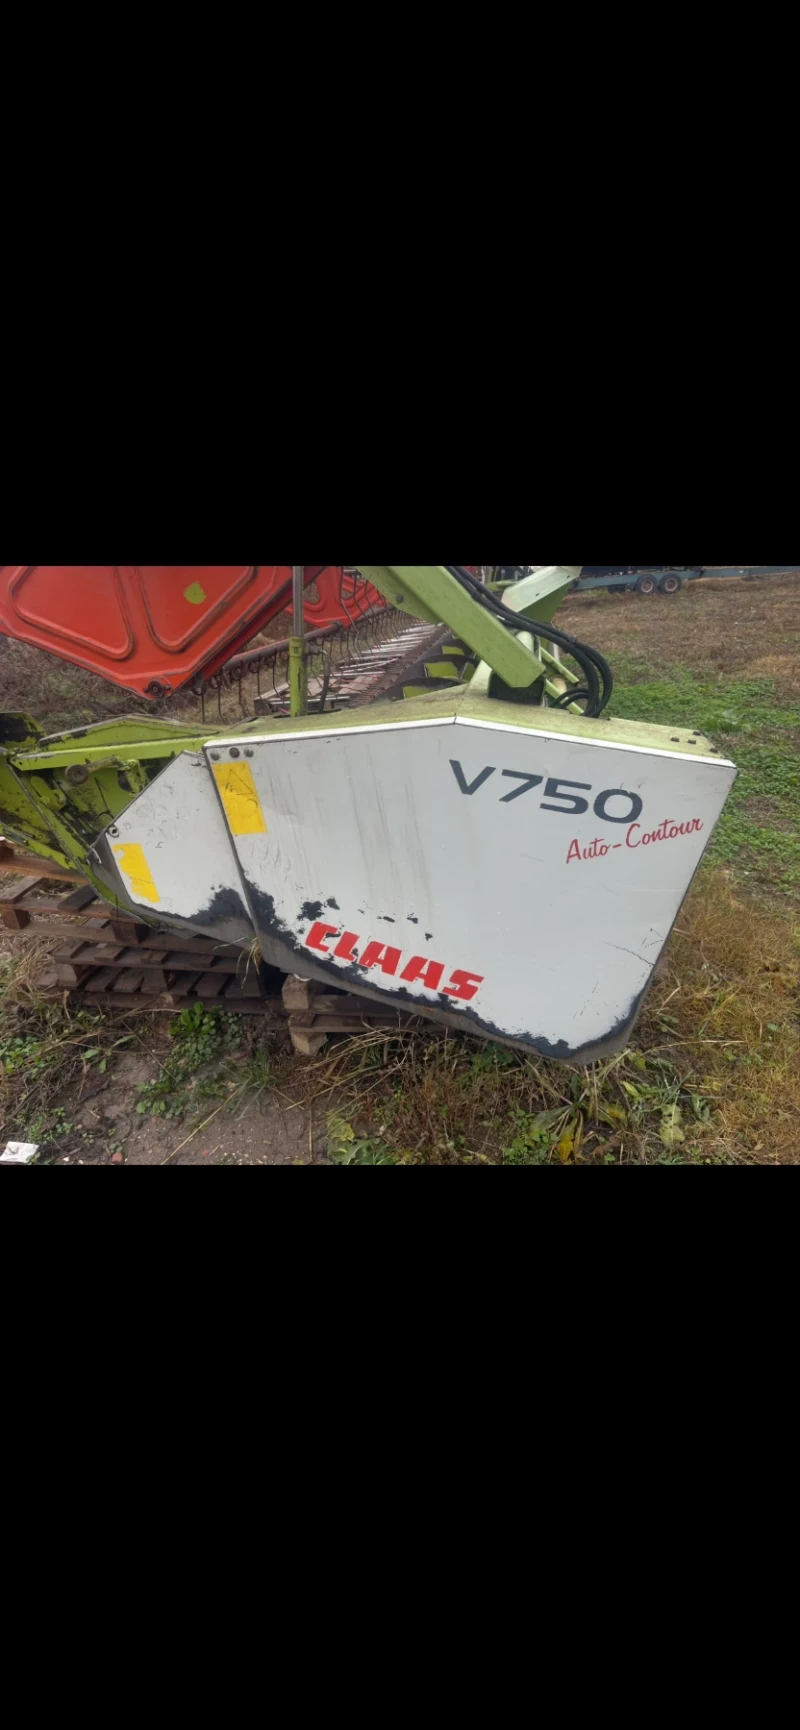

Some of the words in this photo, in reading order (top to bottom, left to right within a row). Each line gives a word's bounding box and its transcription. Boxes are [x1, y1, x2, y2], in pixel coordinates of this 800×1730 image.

[449, 759, 643, 823] V750
[566, 817, 703, 864] Auto-Contour
[305, 921, 484, 1001] CLAAS
